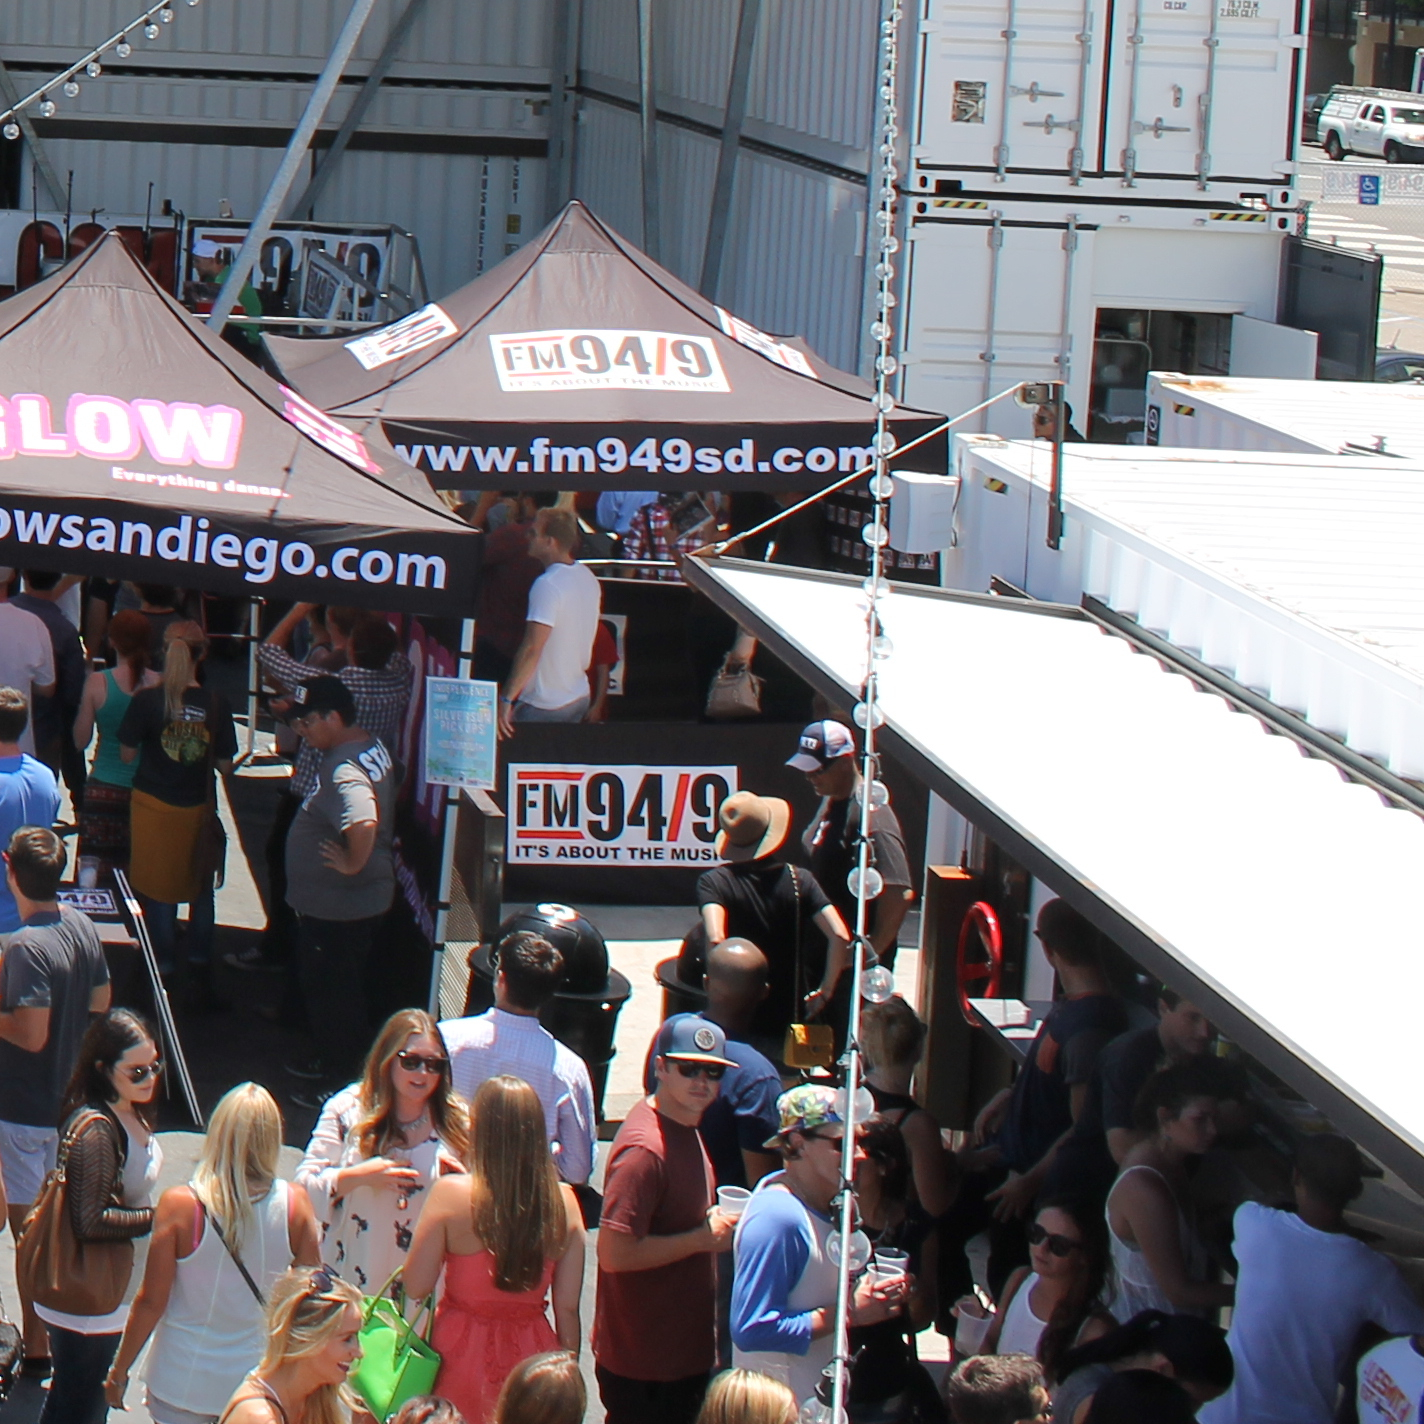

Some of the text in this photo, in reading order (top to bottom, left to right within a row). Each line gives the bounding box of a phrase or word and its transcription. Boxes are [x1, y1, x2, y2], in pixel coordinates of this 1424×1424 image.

[552, 377, 612, 386] ABOUT
[621, 377, 657, 386] THE
[661, 379, 721, 389] MUSIC
[392, 436, 880, 475] www.fm949sd.com
[112, 466, 222, 493] Everything
[515, 844, 725, 862] IT'S ABOUT THE MUSI
